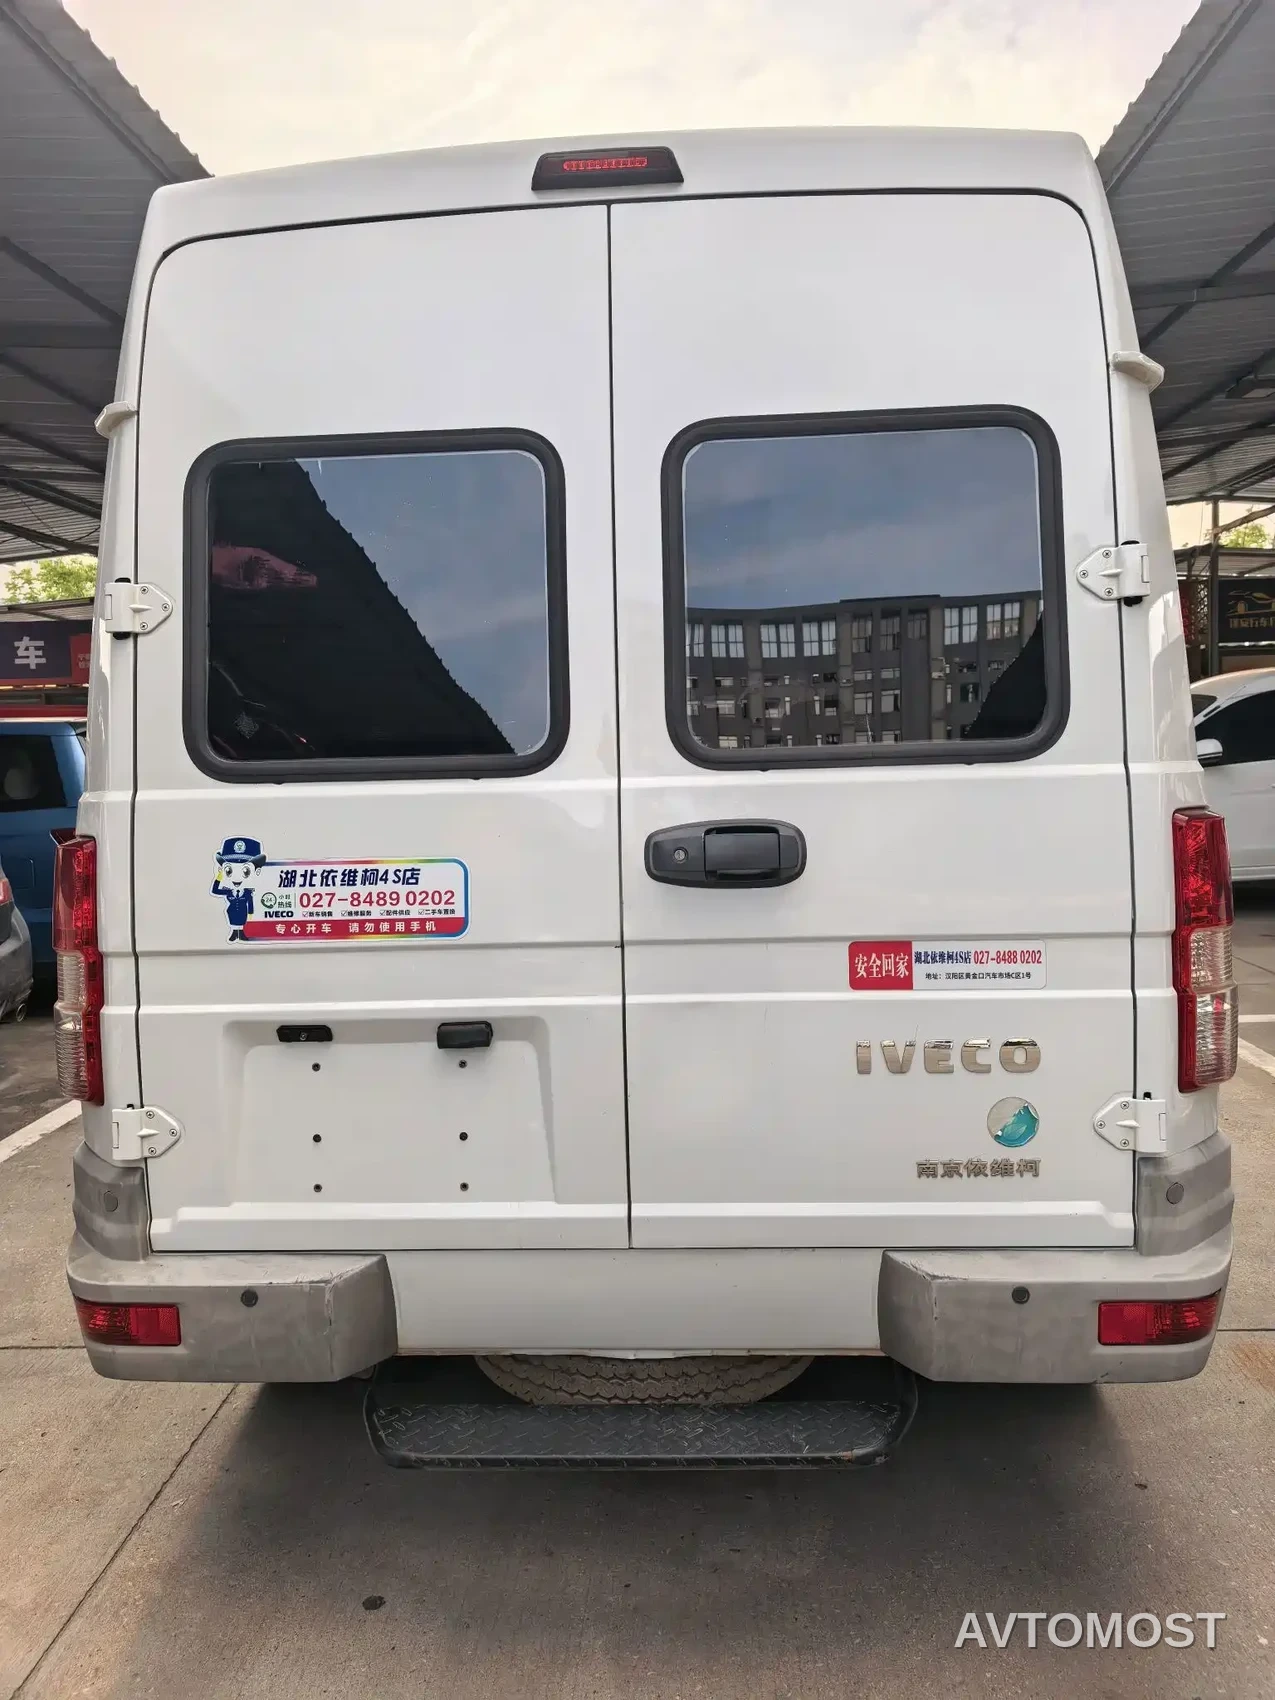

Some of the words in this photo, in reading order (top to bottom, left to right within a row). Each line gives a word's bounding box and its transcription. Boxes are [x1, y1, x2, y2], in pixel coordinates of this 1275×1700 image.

[14, 636, 46, 669] 车
[278, 867, 421, 888] 湖北依维柯4S店
[299, 890, 401, 908] 027-8489
[405, 890, 455, 907] 0202
[275, 922, 332, 934] 专心开车
[348, 921, 437, 933] 请勿使用手机
[854, 953, 910, 979] 安全回家
[914, 951, 972, 965] 湖北依维柯4S店
[973, 950, 1018, 965] 027-8488
[1020, 949, 1042, 964] 0202
[856, 1037, 1042, 1075] IVECO
[916, 1157, 1042, 1179] 南京依维柯
